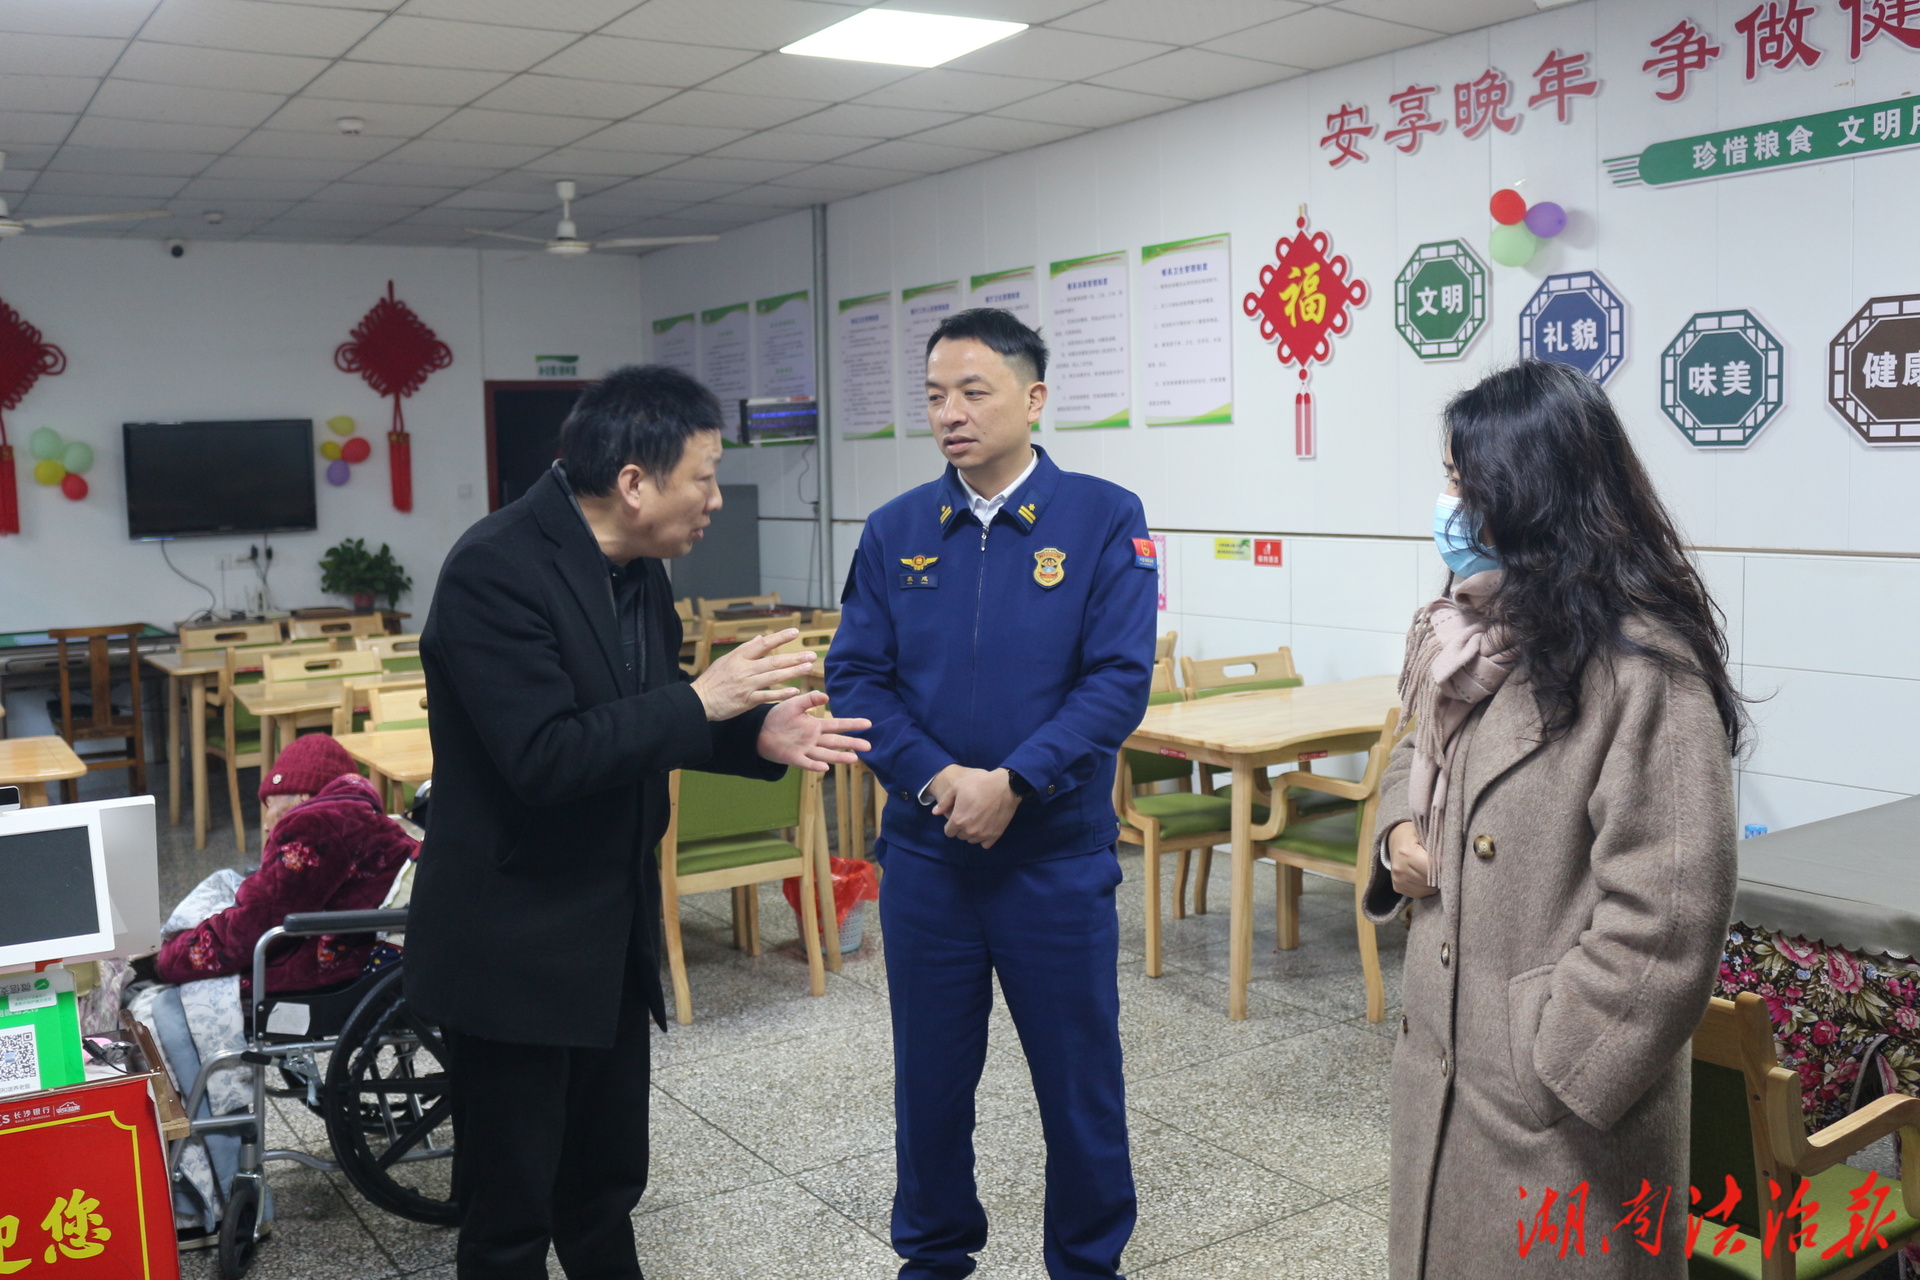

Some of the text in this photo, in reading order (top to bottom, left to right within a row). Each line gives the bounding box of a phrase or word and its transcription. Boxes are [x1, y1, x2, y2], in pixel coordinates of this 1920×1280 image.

[1320, 49, 1599, 167] 安享晚年
[1692, 124, 1814, 171] 珍惜粮食
[1278, 261, 1328, 328] 福
[1416, 284, 1464, 317] 文明
[1542, 318, 1599, 353] 礼貌
[1688, 360, 1752, 397] 味美
[13, 1106, 51, 1120] 长沙银行
